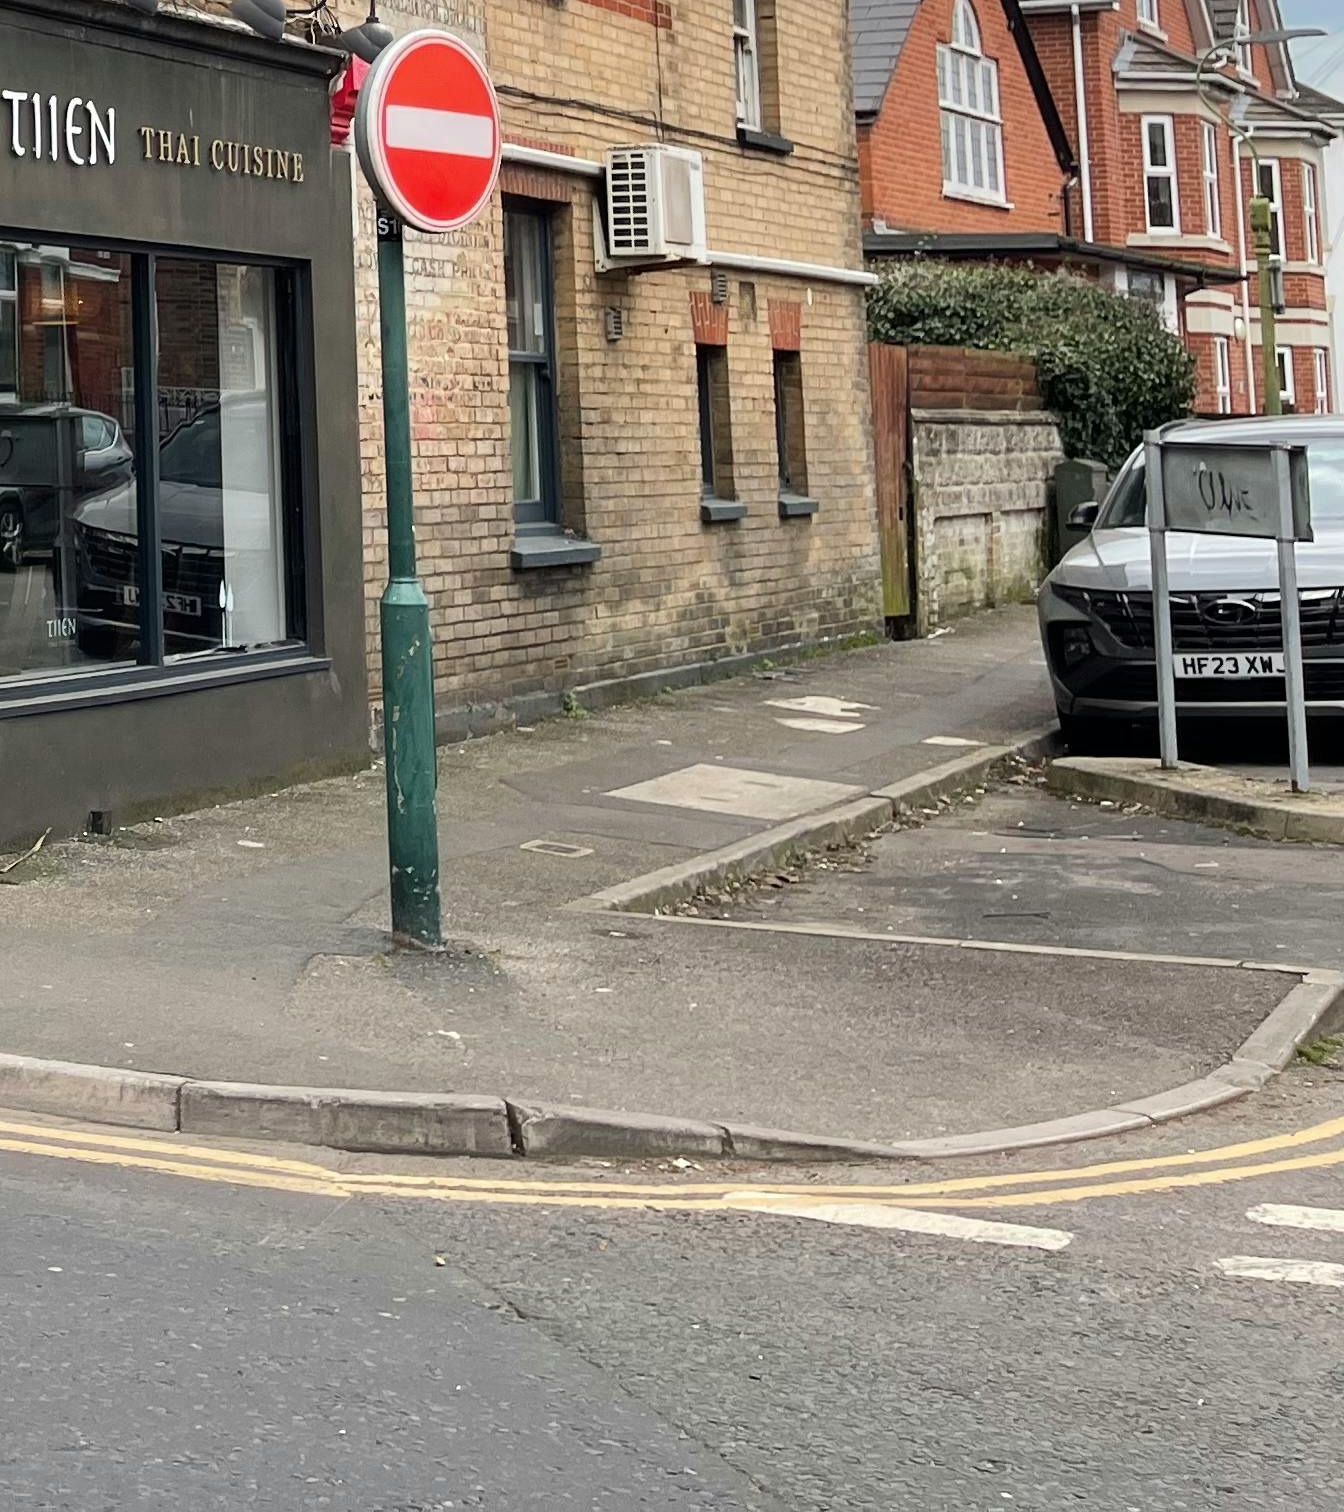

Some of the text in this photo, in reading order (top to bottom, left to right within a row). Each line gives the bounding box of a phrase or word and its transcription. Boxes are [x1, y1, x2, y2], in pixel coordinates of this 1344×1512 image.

[2, 89, 305, 182] TIIEN THAI CUISINE
[46, 617, 77, 638] TIIEN
[1182, 656, 1239, 675] HF23
